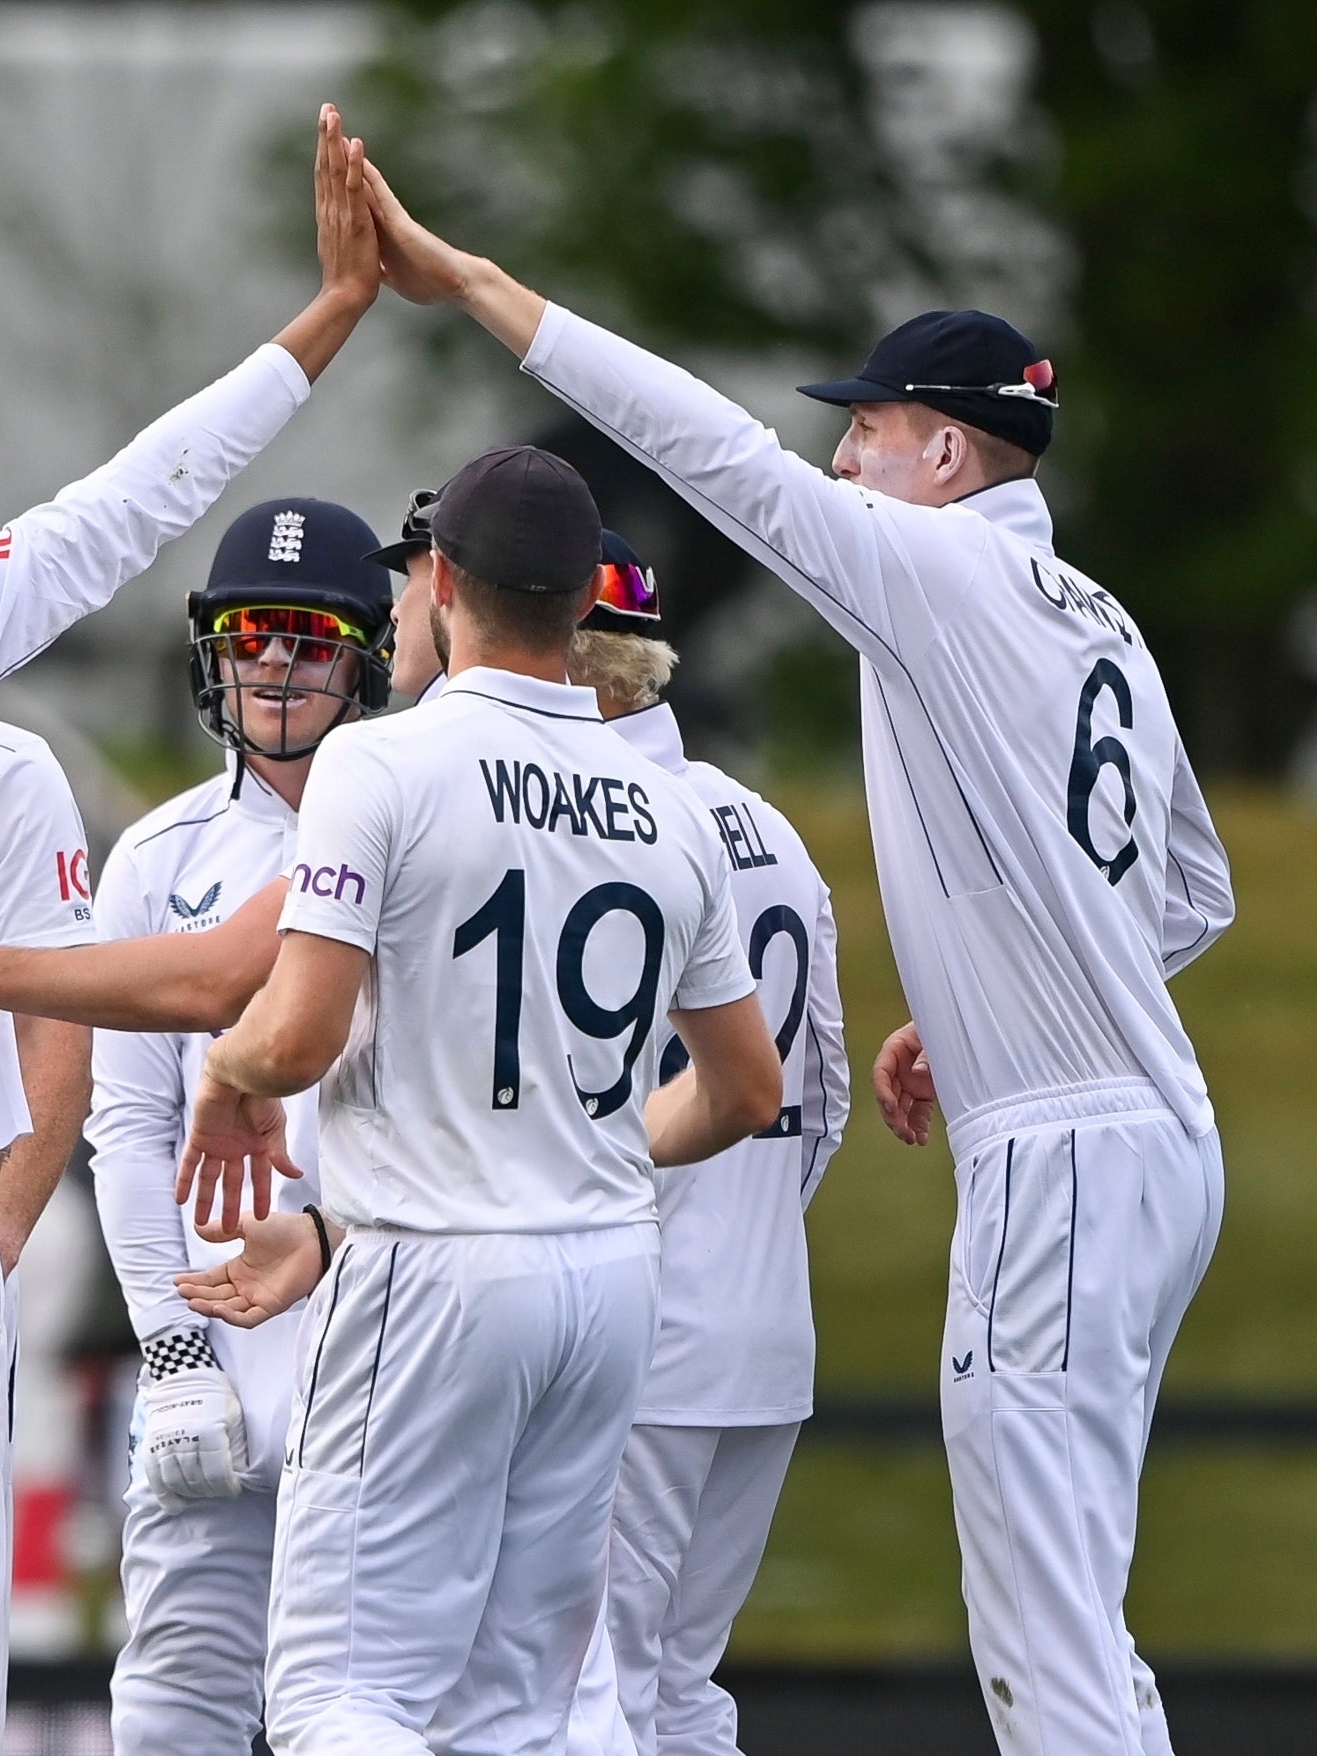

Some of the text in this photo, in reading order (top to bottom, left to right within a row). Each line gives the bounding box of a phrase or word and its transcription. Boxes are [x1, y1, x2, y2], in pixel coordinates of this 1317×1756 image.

[479, 759, 658, 846] WOAKES
[1067, 657, 1140, 888] 6
[74, 907, 91, 921] BS
[452, 868, 665, 1121] 19
